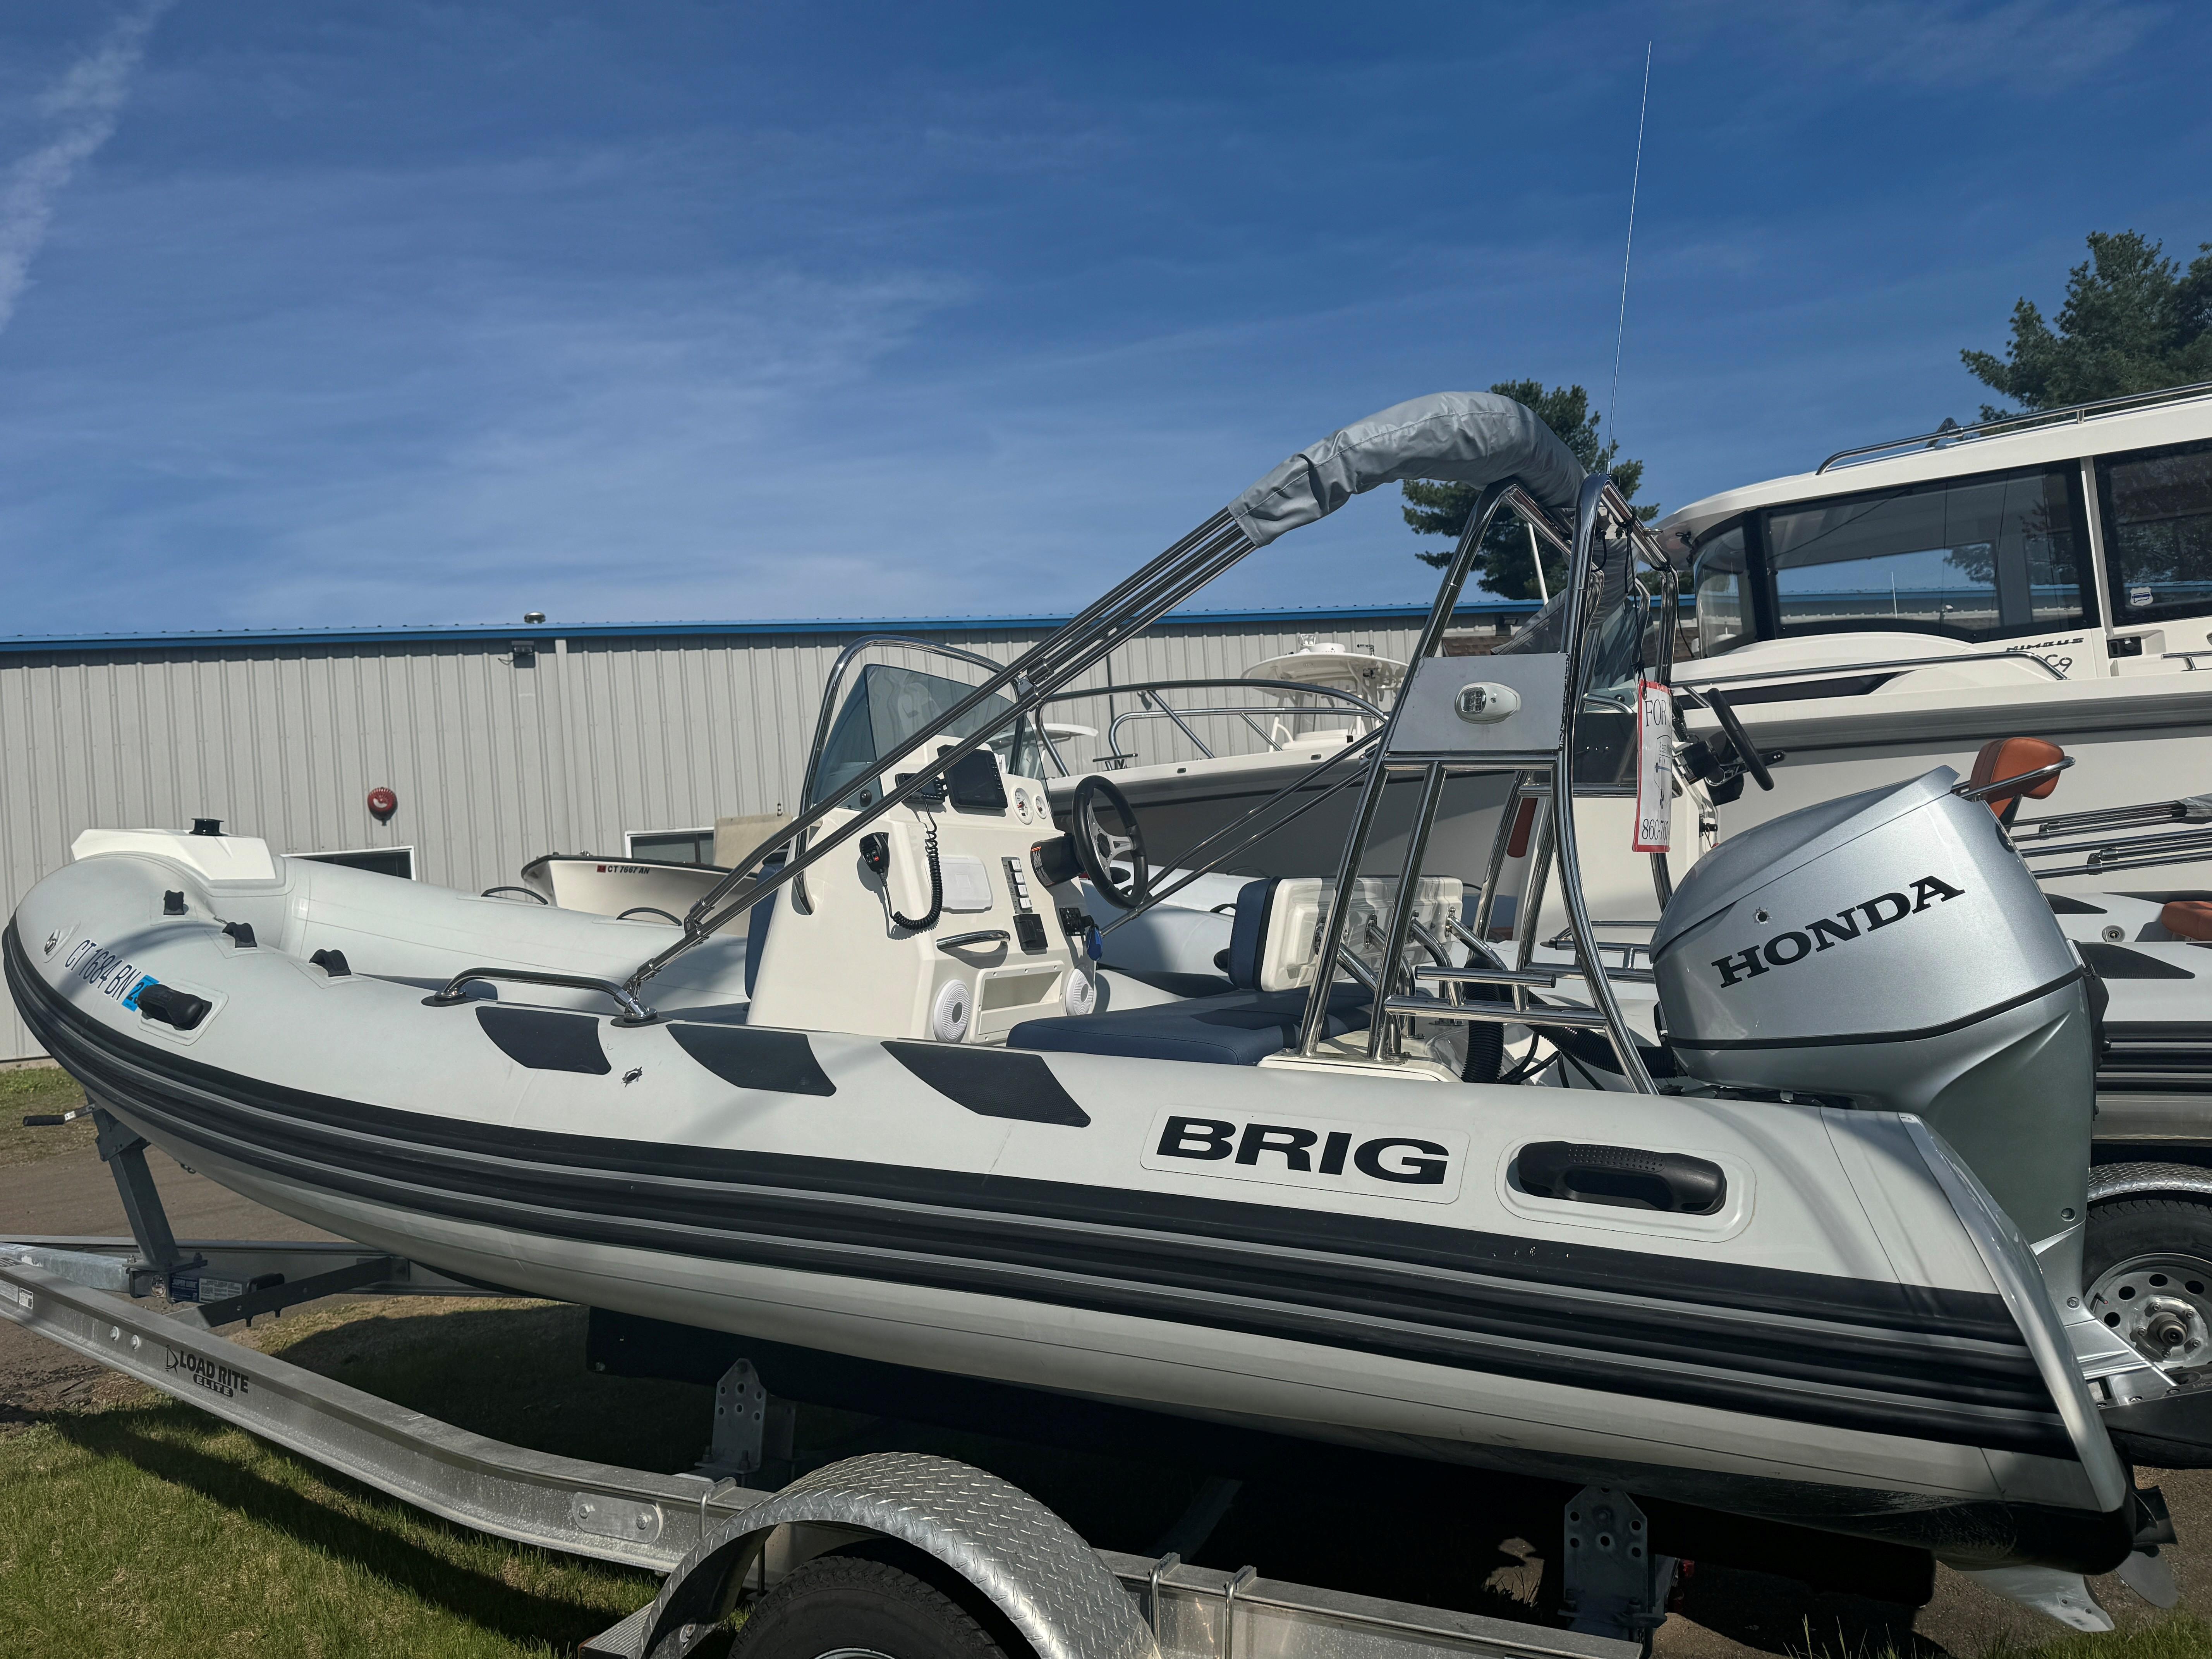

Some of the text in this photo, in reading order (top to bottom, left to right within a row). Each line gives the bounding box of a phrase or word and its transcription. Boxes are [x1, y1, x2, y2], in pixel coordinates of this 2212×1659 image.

[1645, 699, 1667, 727] FOR
[607, 865, 618, 873] CT
[1711, 875, 1966, 989] HONDA
[65, 939, 142, 1001] CT 1684 BN
[1156, 1115, 1449, 1185] BRIG
[180, 1350, 249, 1394] LOAD RITE
[196, 1375, 230, 1396] ELITE
